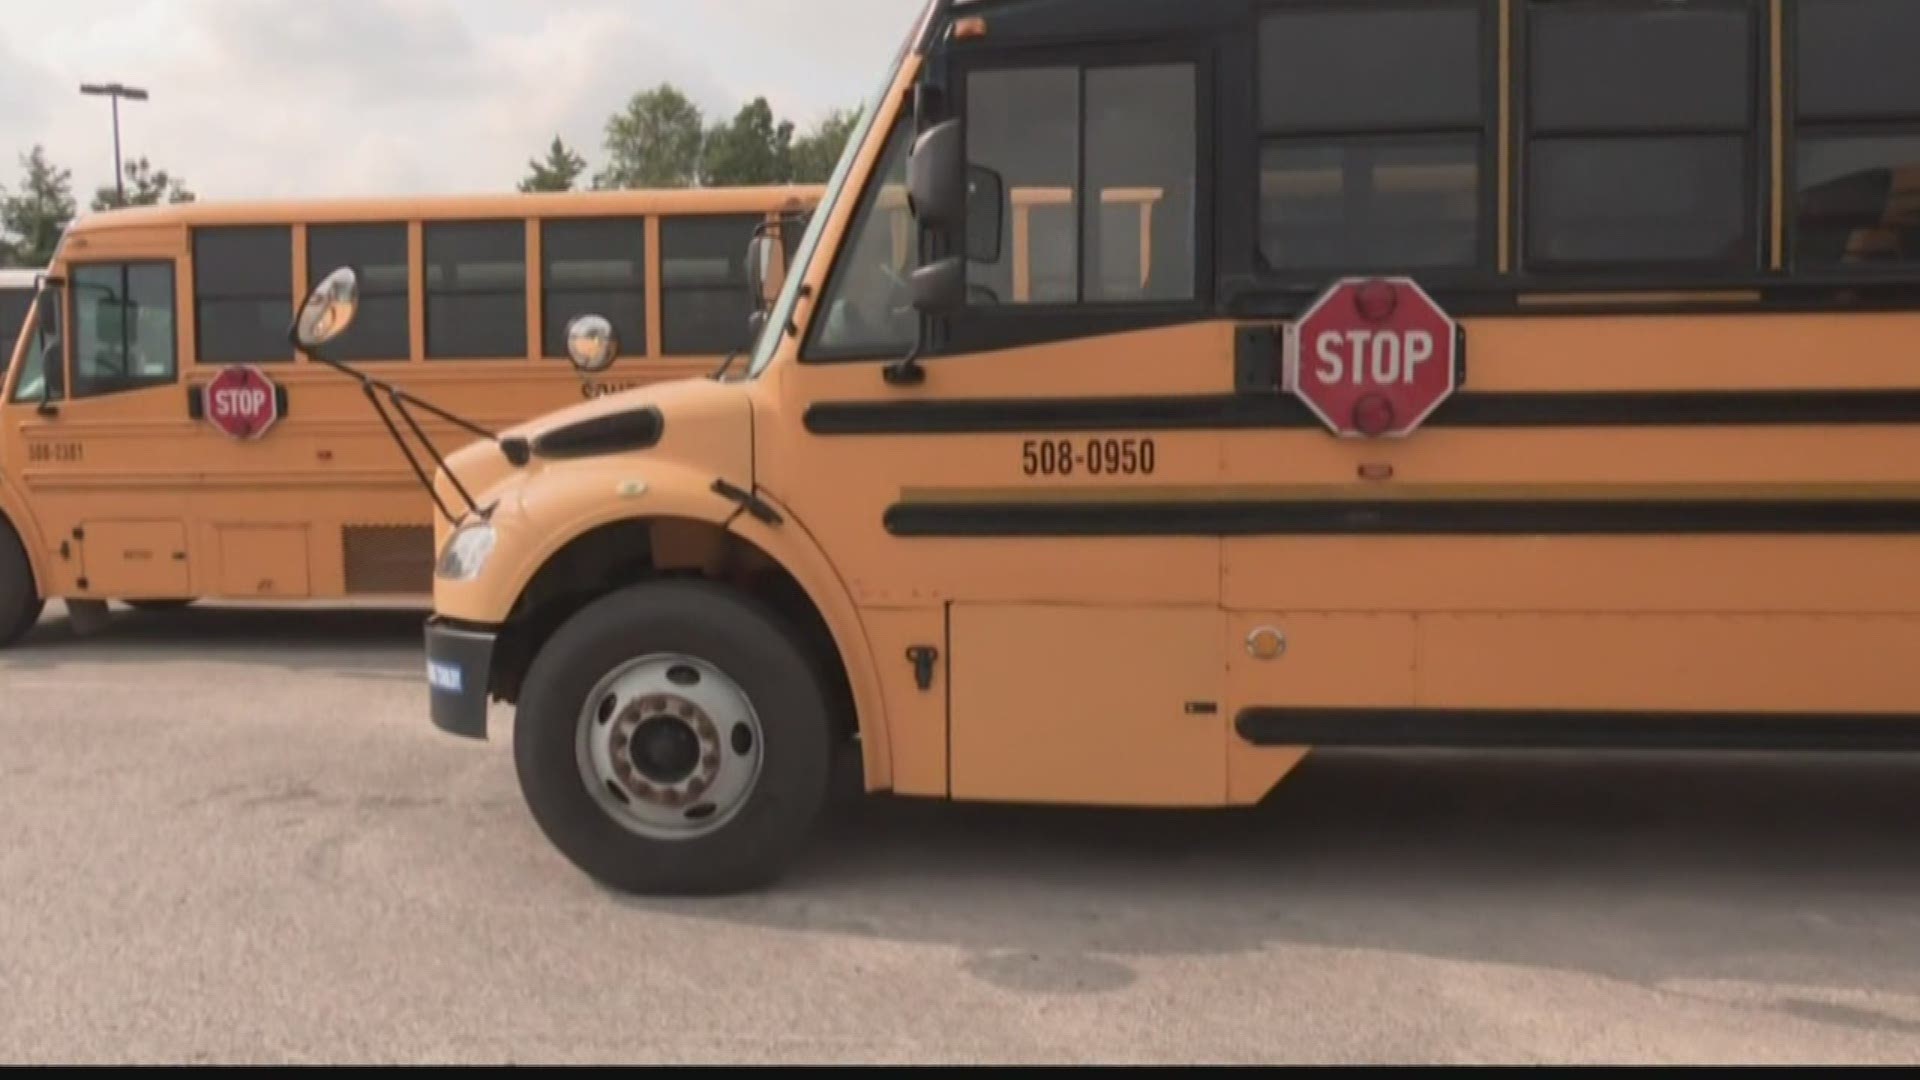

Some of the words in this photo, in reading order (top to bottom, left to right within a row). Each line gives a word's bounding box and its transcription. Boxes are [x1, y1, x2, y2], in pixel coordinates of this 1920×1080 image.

[1315, 329, 1434, 385] STOP
[215, 388, 266, 417] STOP
[1022, 438, 1155, 475] 508-0950
